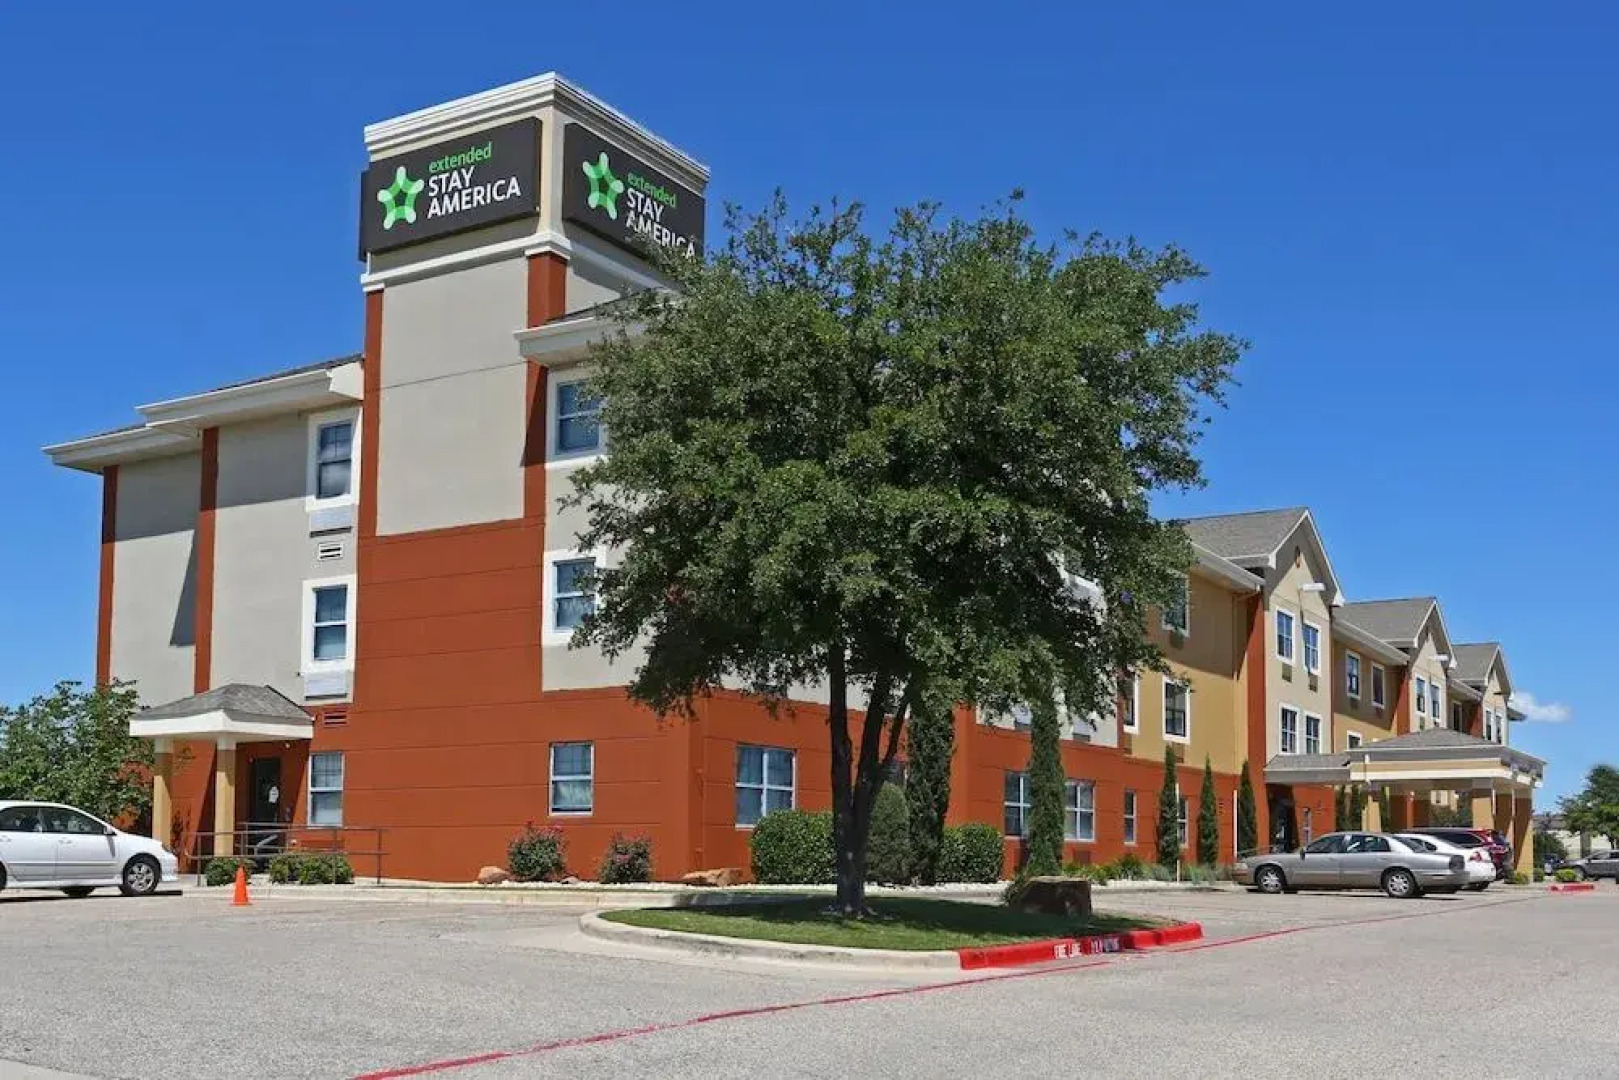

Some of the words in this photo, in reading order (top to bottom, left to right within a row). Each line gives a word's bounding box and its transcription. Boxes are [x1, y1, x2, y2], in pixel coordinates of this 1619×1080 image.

[428, 141, 493, 173] extended
[427, 176, 521, 219] AMERICA
[428, 165, 475, 197] STAY
[627, 172, 676, 208] extended
[627, 187, 664, 222] STAY
